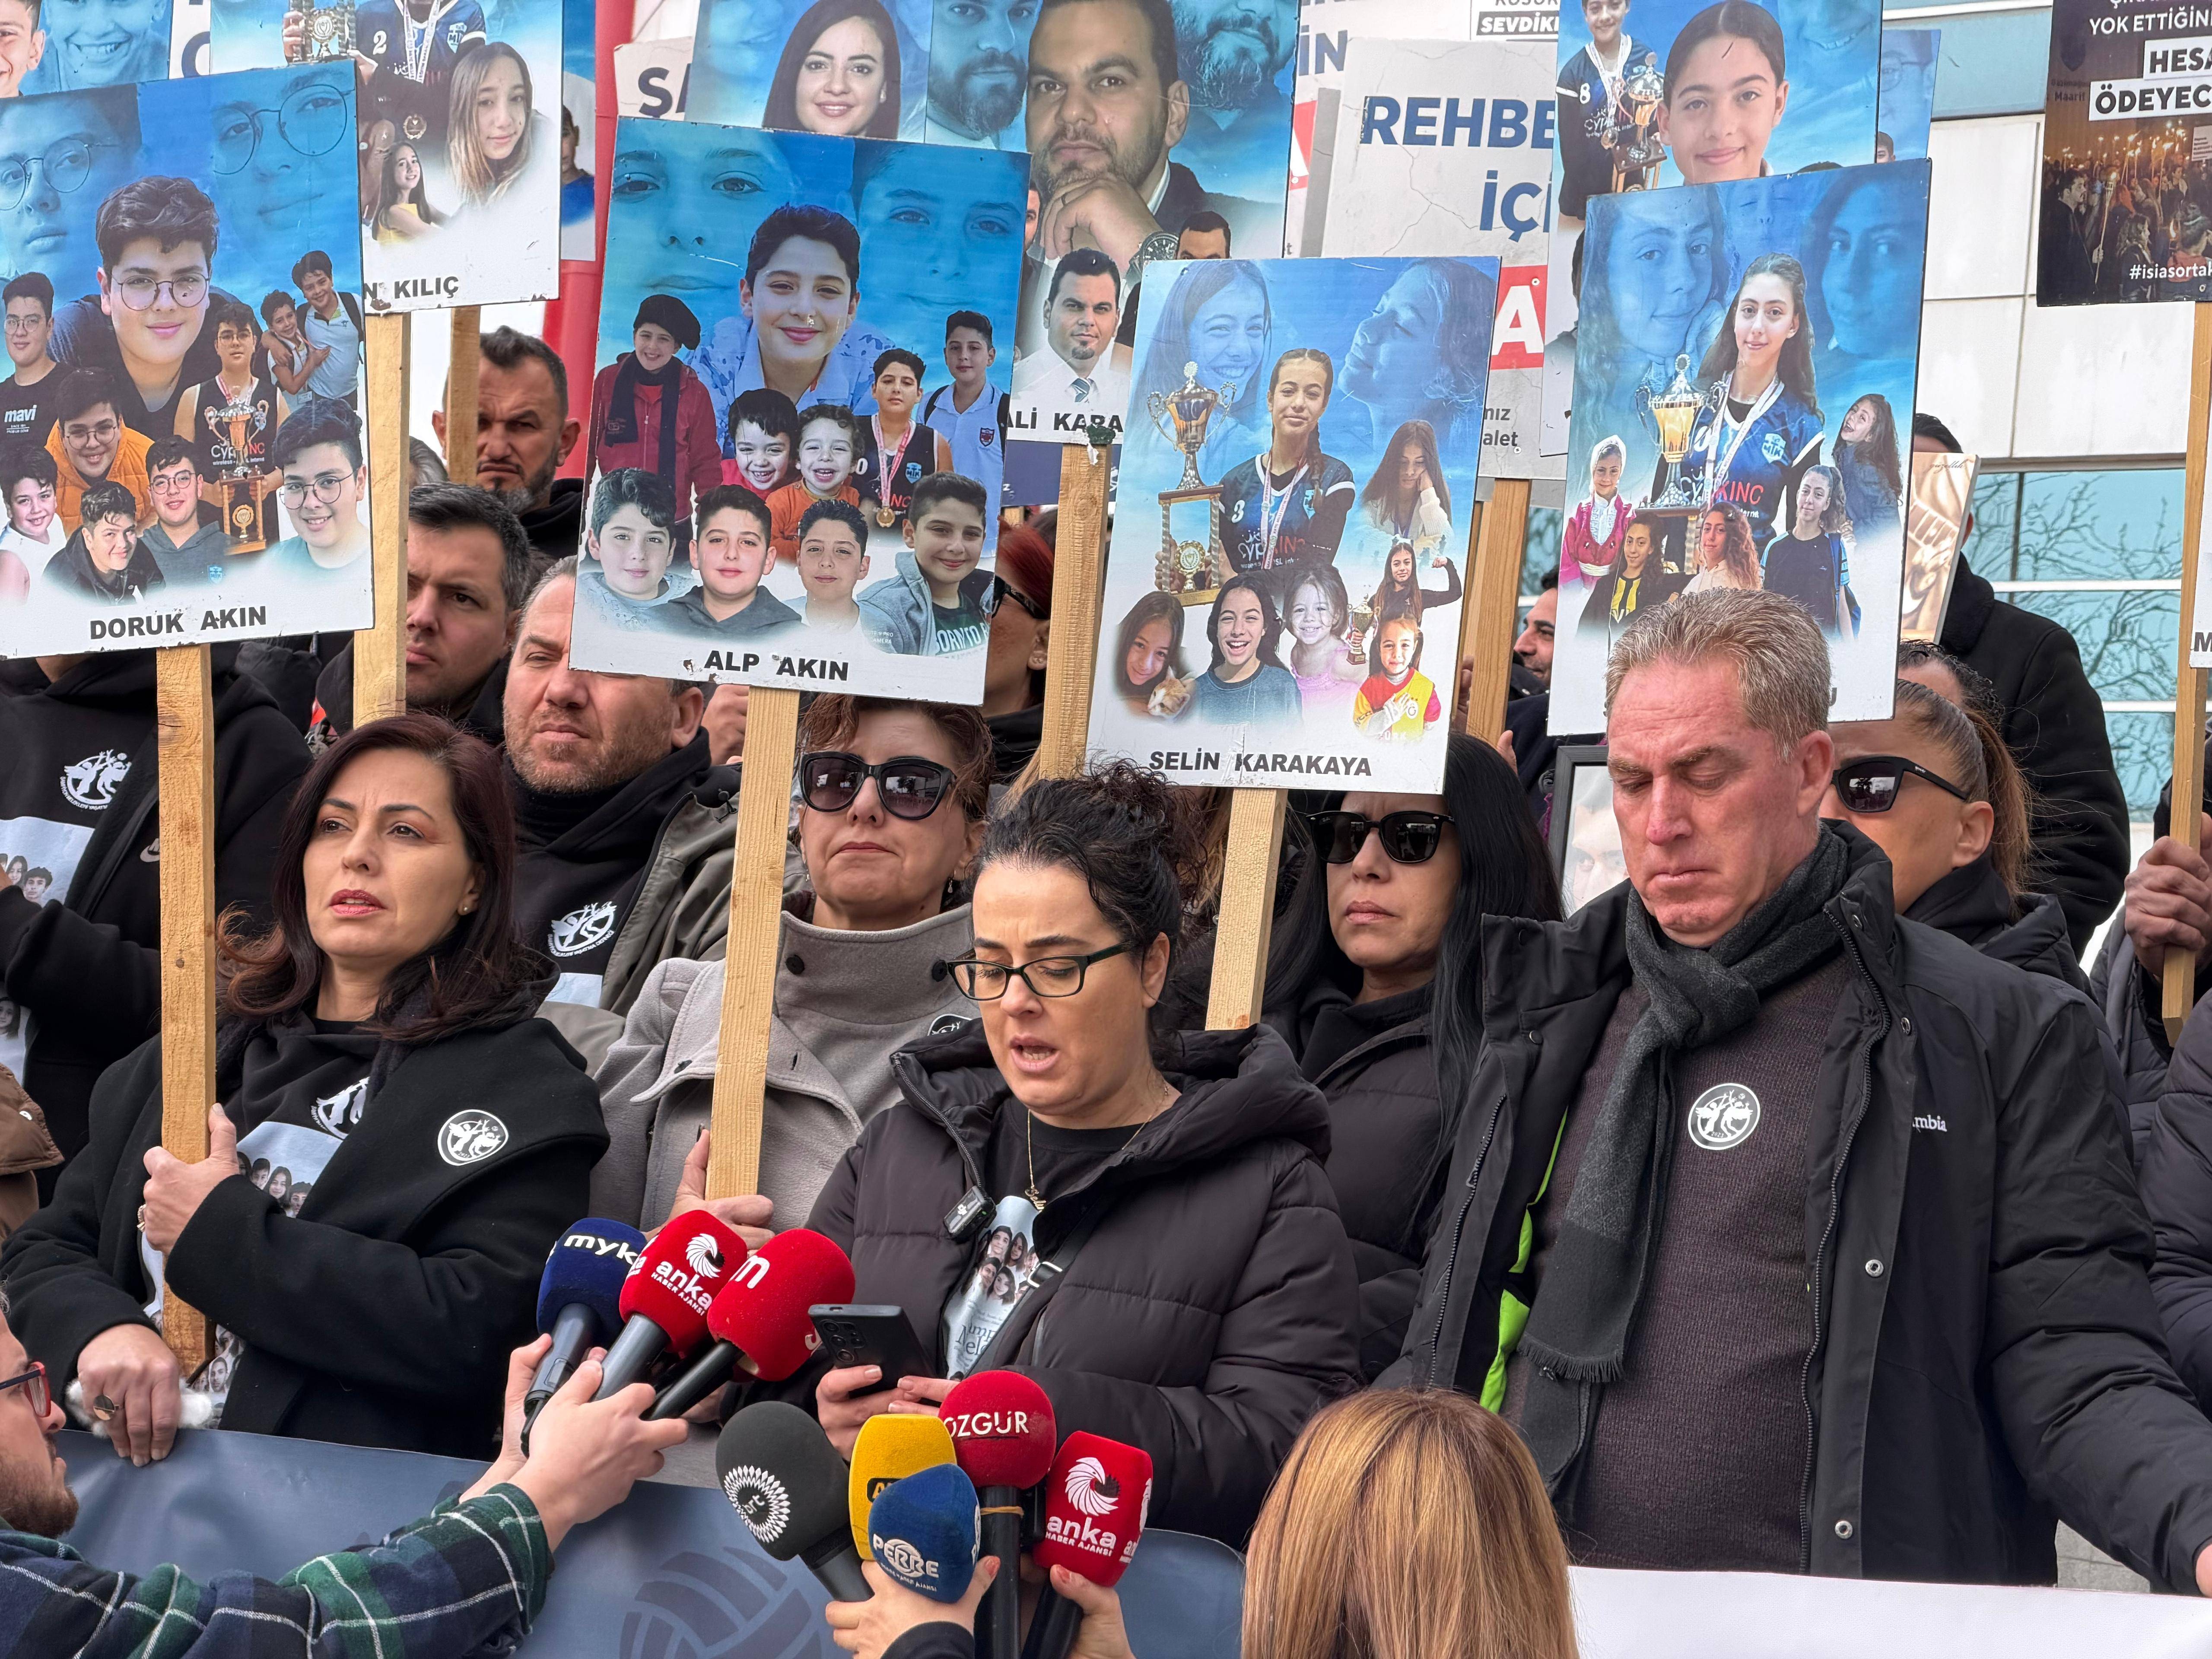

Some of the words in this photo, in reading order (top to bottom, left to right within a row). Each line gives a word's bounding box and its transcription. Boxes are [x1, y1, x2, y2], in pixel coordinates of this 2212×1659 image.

[2089, 16, 2129, 35] YOK
[2133, 5, 2212, 32] ETTİĞİN
[373, 30, 387, 55] 2
[1580, 83, 1591, 104] 8
[394, 276, 459, 299] KILIÇ
[4, 404, 37, 423] mavi
[1231, 499, 1246, 523] 3
[90, 611, 184, 639] DORUK
[200, 606, 266, 630] AKIN
[703, 650, 760, 672] ALP
[776, 656, 849, 681] AKIN
[1149, 747, 1220, 770] SELİN
[1234, 753, 1372, 776] KARAKAYA
[651, 1271, 679, 1294] HABER
[677, 1291, 707, 1316] AJANSI
[656, 1261, 714, 1311] anka
[1045, 1532, 1076, 1546] HABER
[1077, 1541, 1113, 1557] AJANSI
[1047, 1516, 1117, 1550] anka
